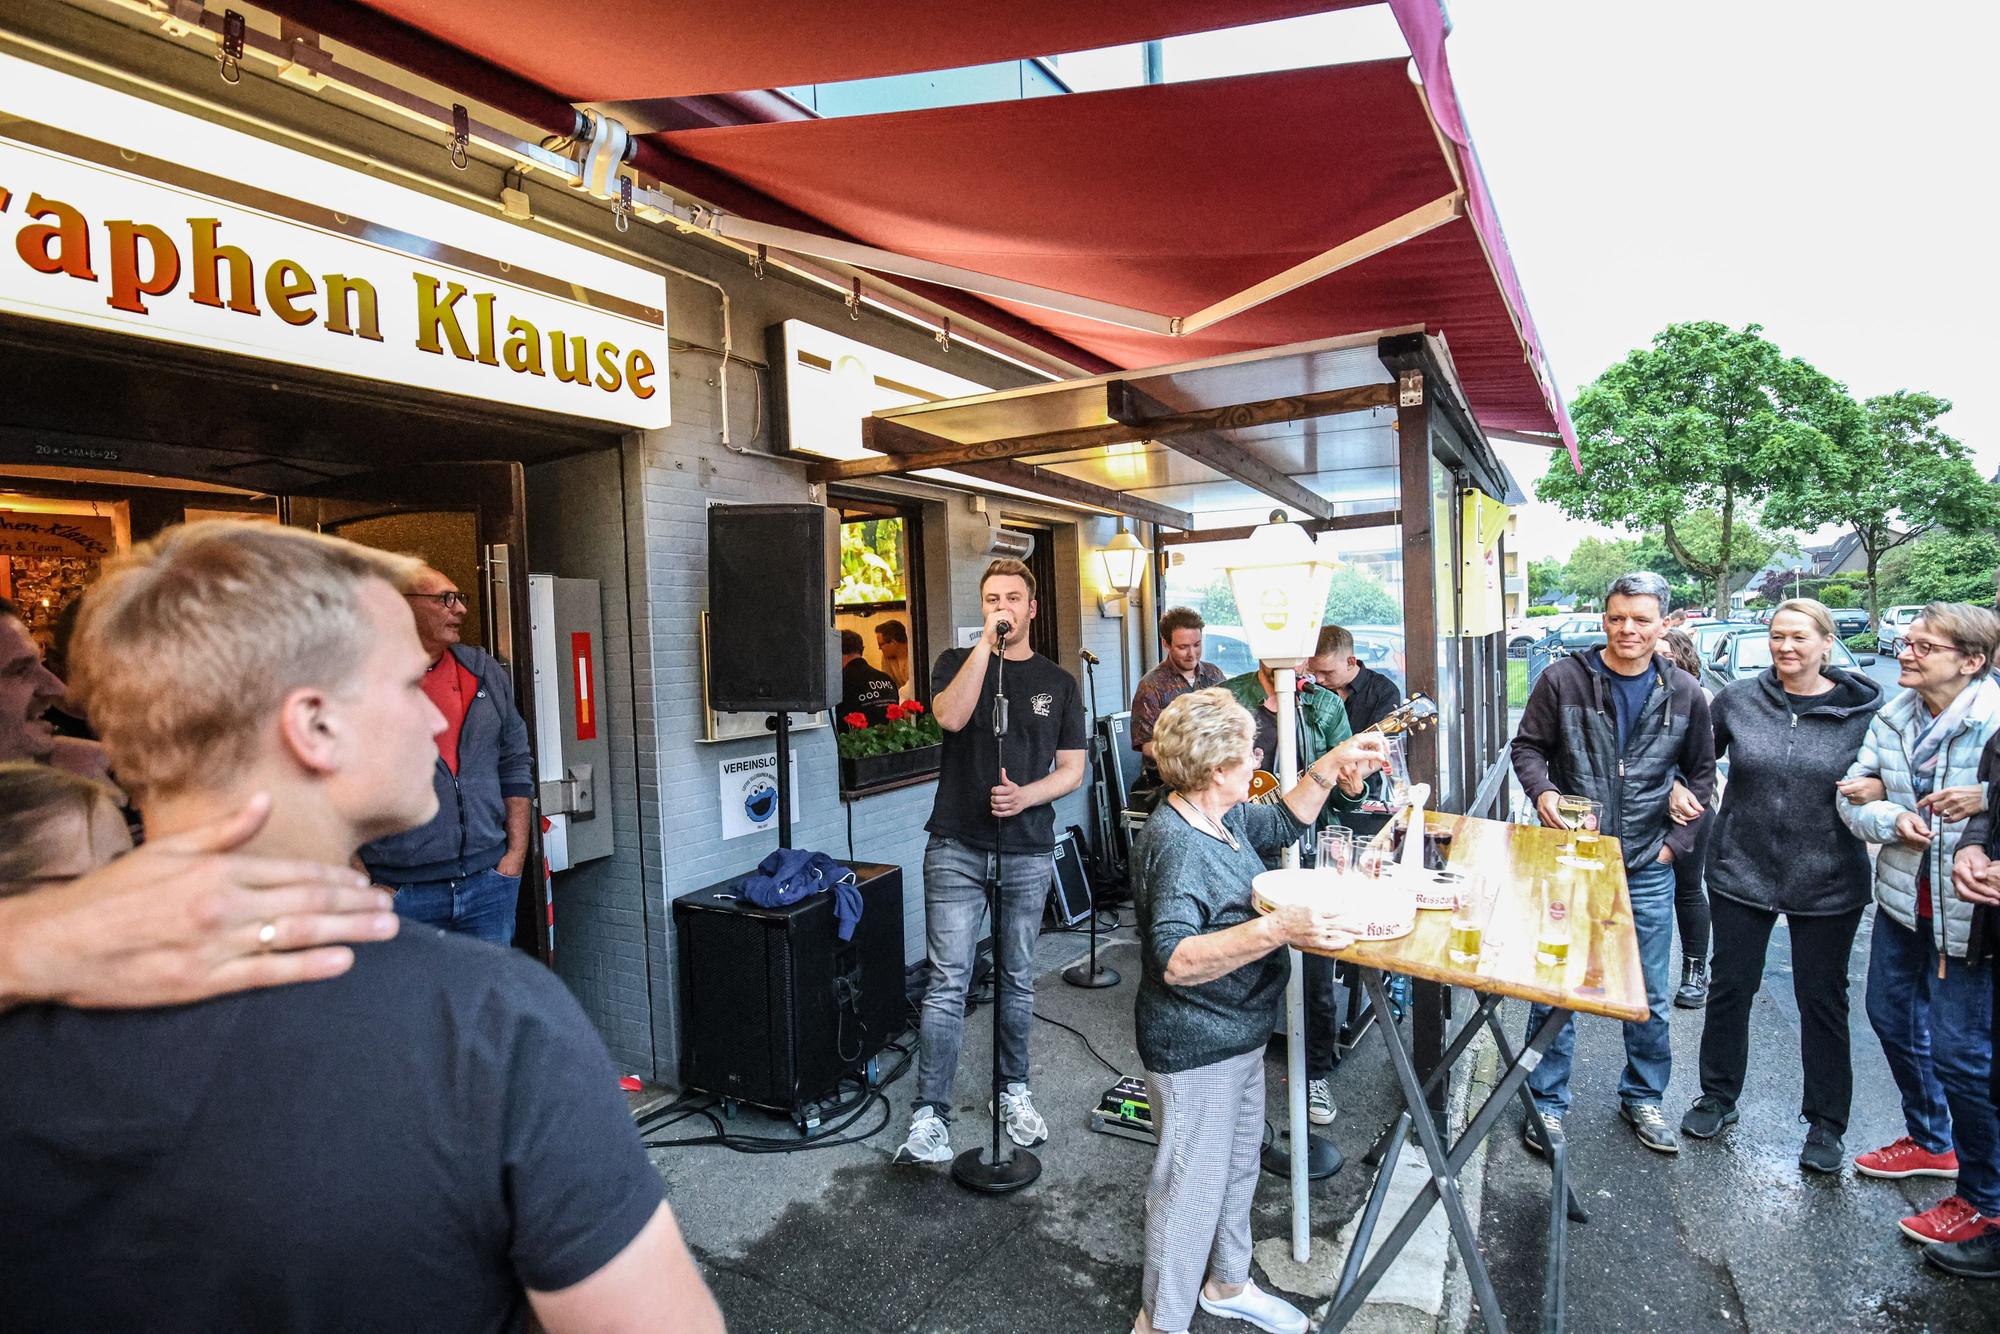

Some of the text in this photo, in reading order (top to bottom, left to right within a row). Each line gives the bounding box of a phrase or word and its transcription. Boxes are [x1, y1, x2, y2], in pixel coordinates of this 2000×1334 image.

[0, 187, 656, 399] aphen Klause
[723, 756, 793, 774] VEREINSLO
